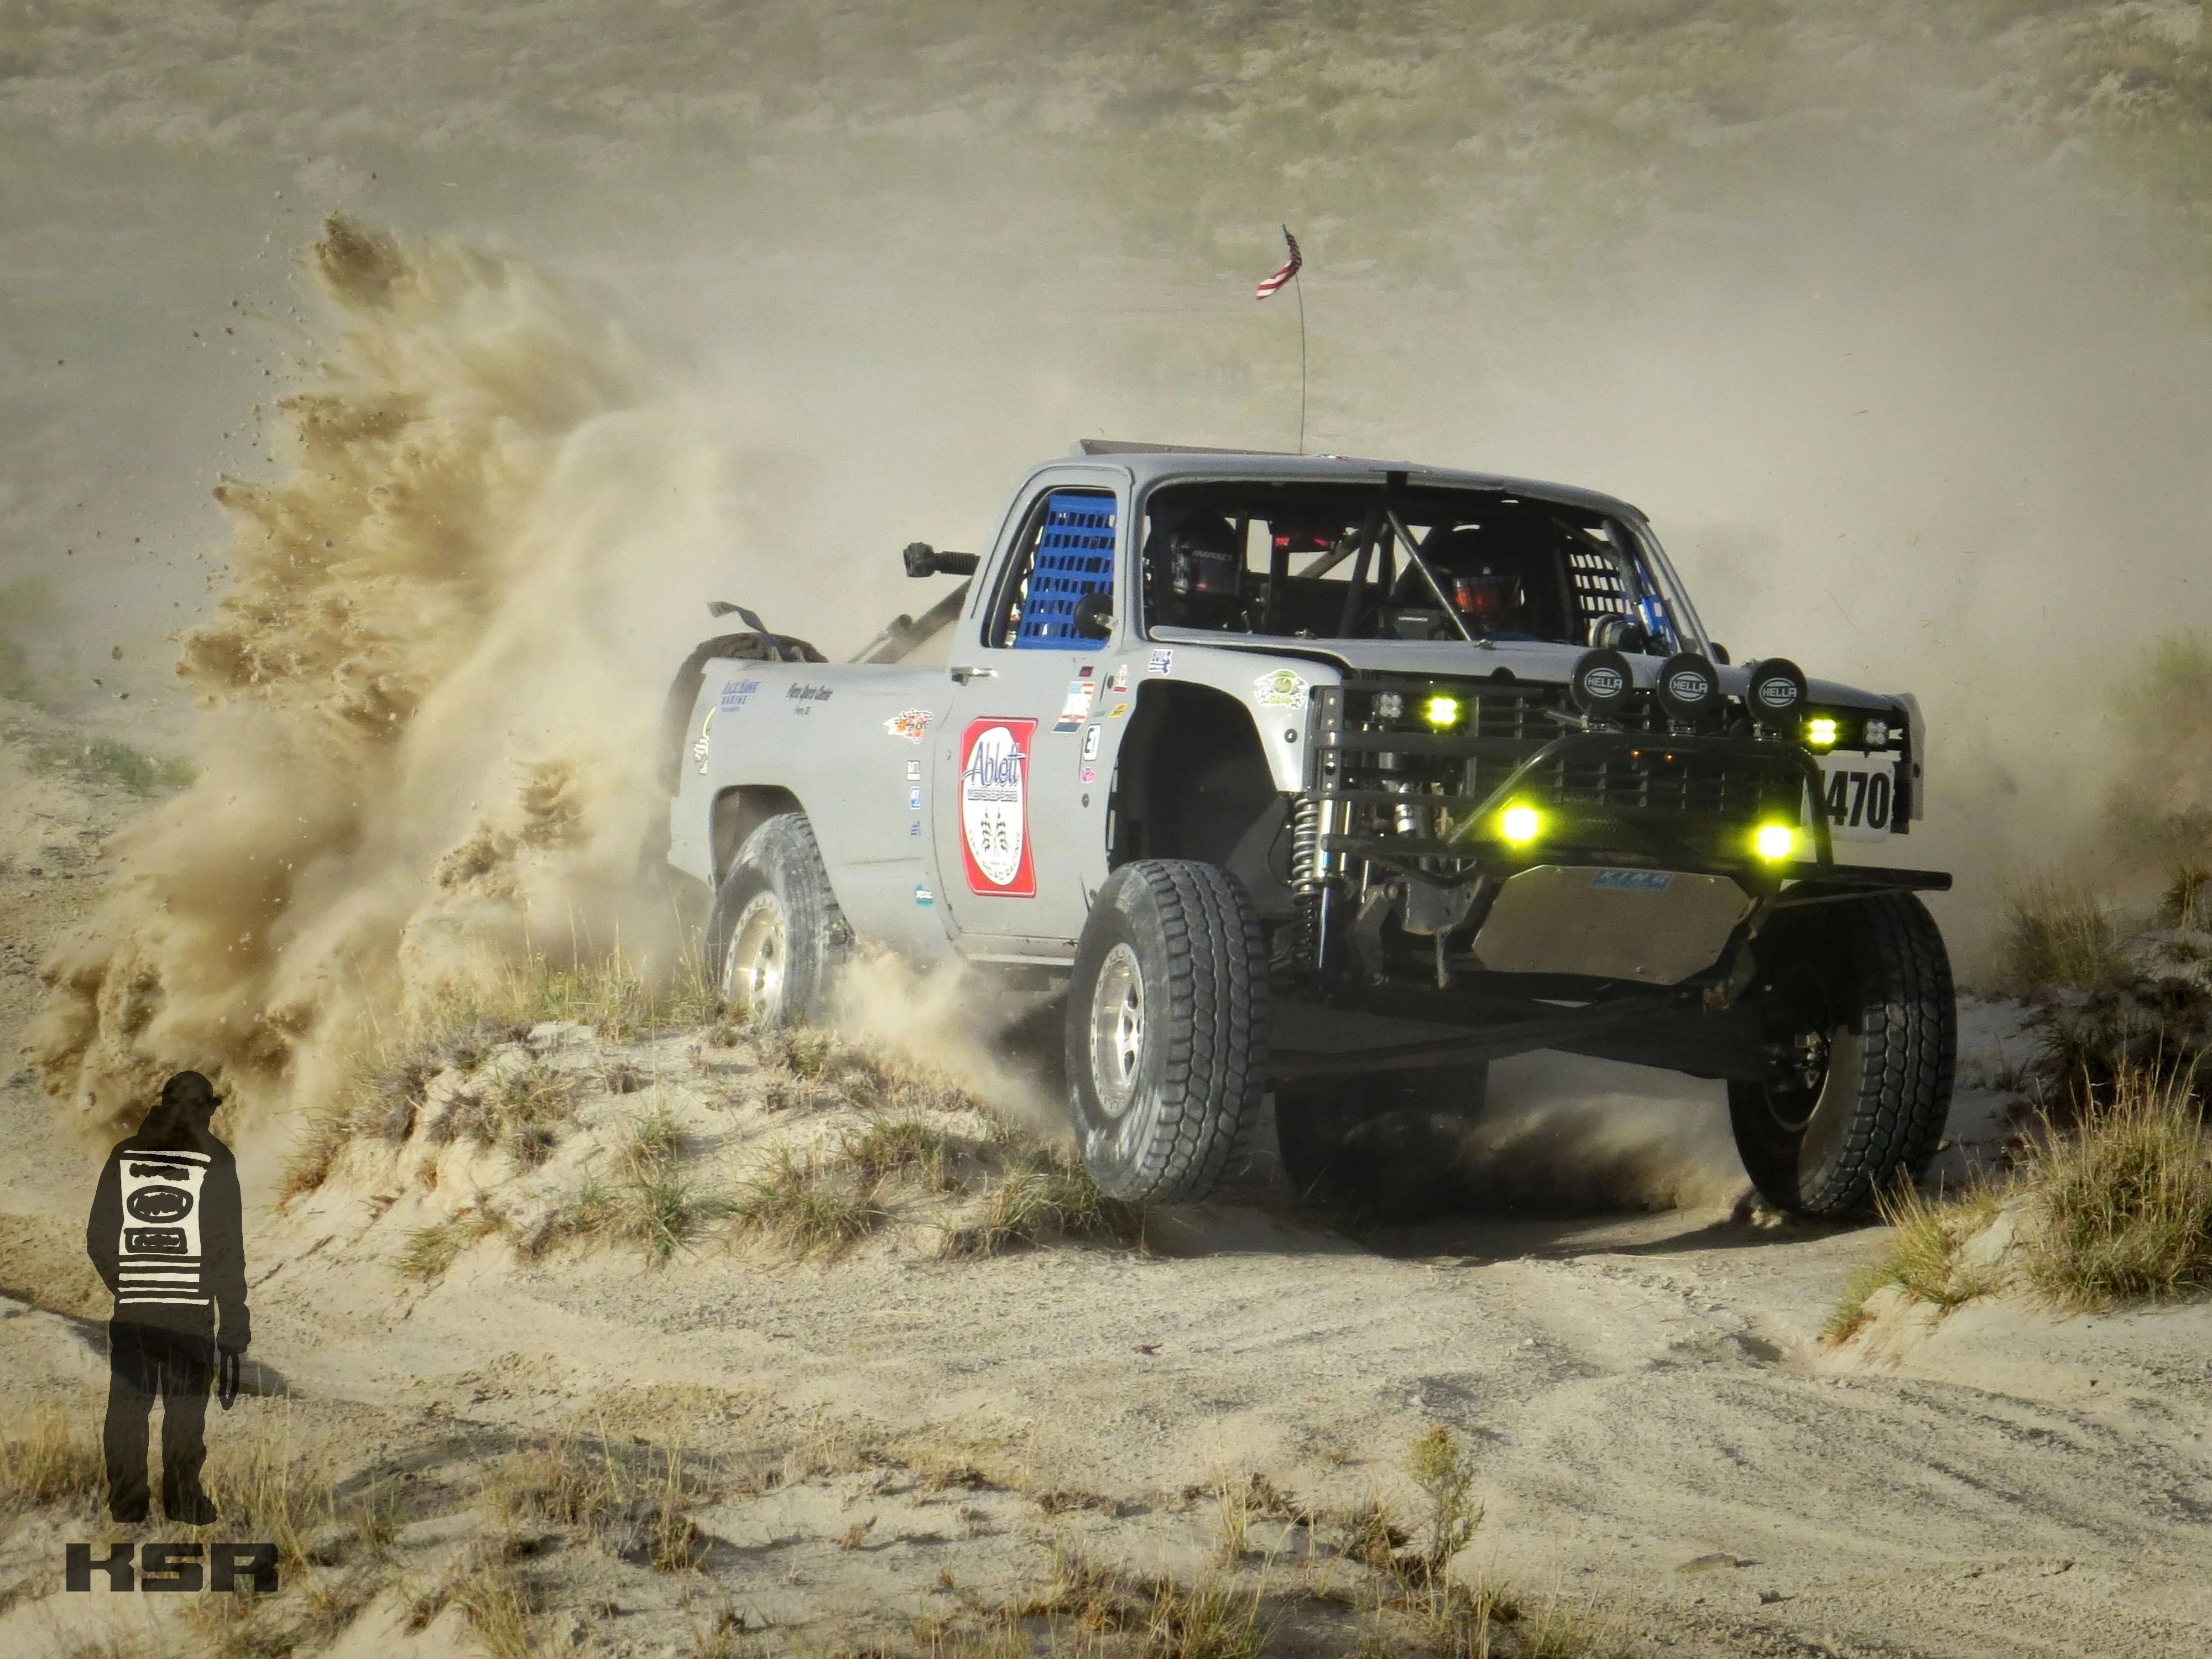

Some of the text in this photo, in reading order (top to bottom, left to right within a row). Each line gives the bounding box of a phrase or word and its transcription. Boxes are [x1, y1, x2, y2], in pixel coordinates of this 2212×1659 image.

[1588, 677, 1623, 690] HELLA
[1673, 681, 1708, 694] HELLA
[1762, 686, 1798, 698] HELLA
[1819, 770, 1890, 830] 470
